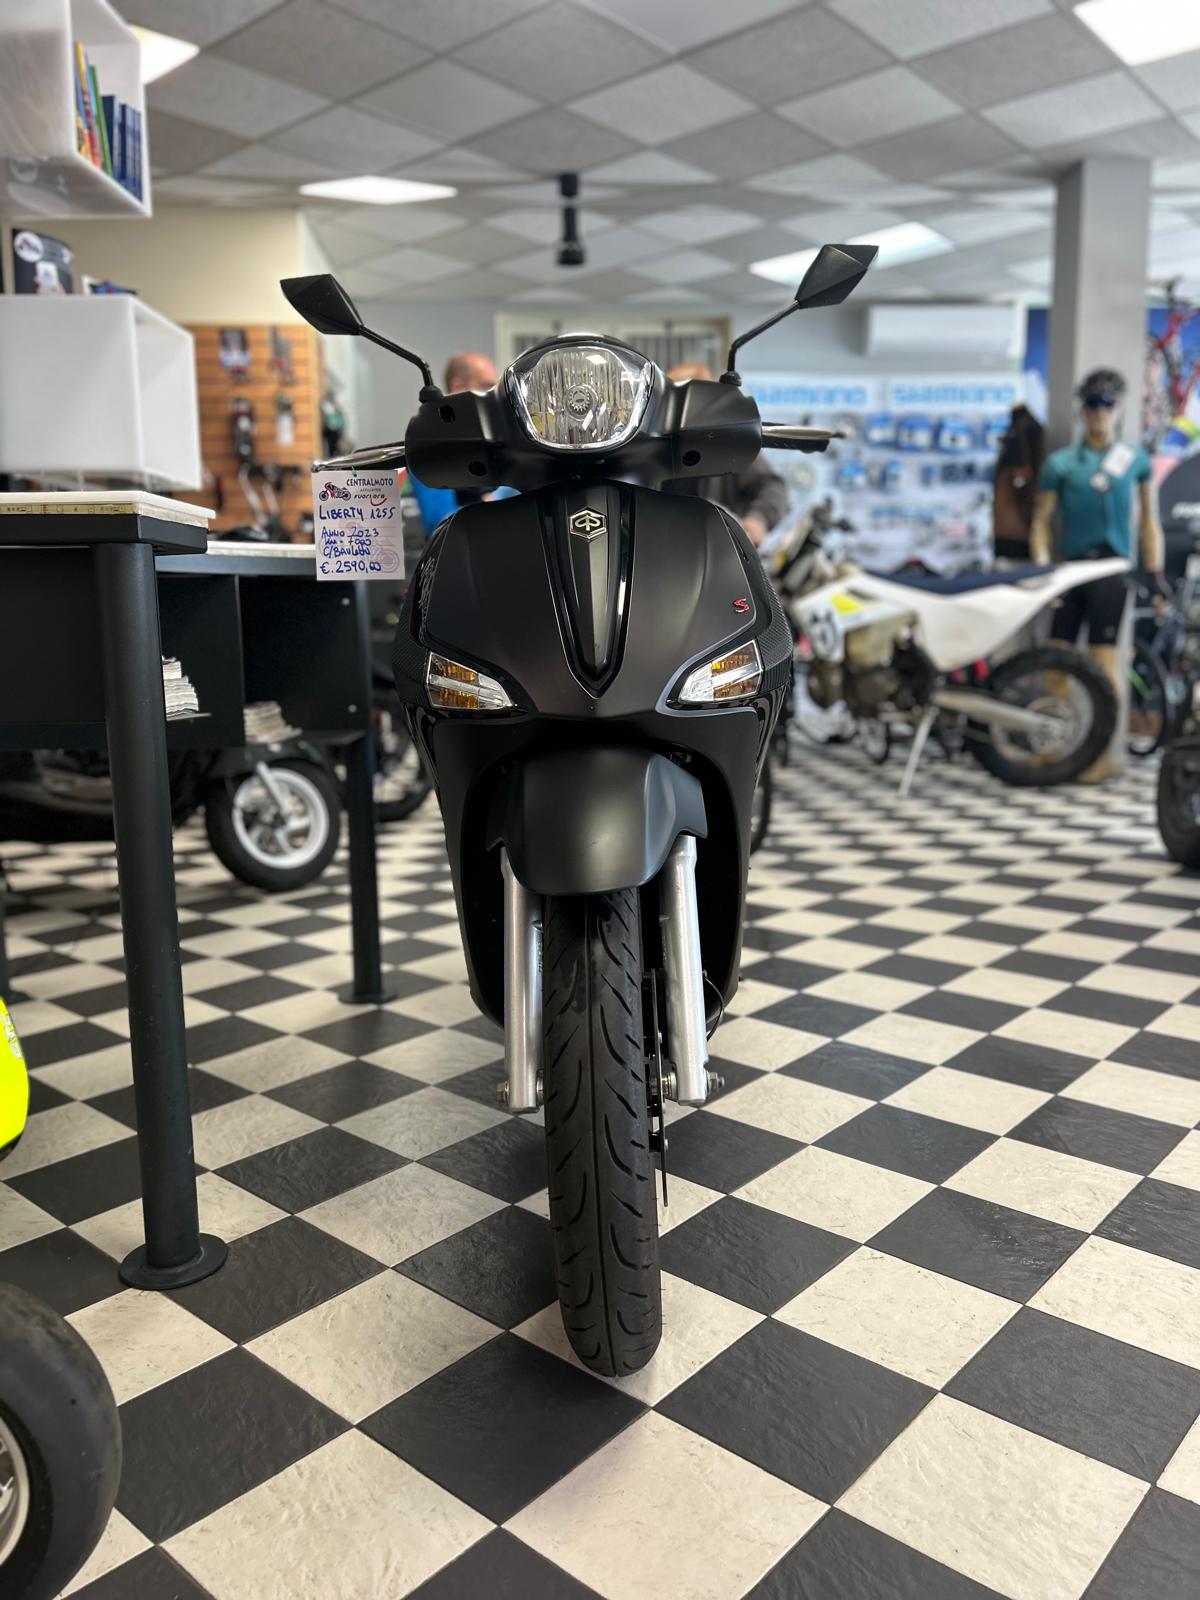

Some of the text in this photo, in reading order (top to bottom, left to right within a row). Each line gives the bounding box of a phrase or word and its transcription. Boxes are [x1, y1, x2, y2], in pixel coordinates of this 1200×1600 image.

[346, 478, 394, 487] CENTRALMOTO
[319, 505, 364, 521] LIBERTY
[347, 527, 379, 537] 2023
[733, 598, 750, 613] S
